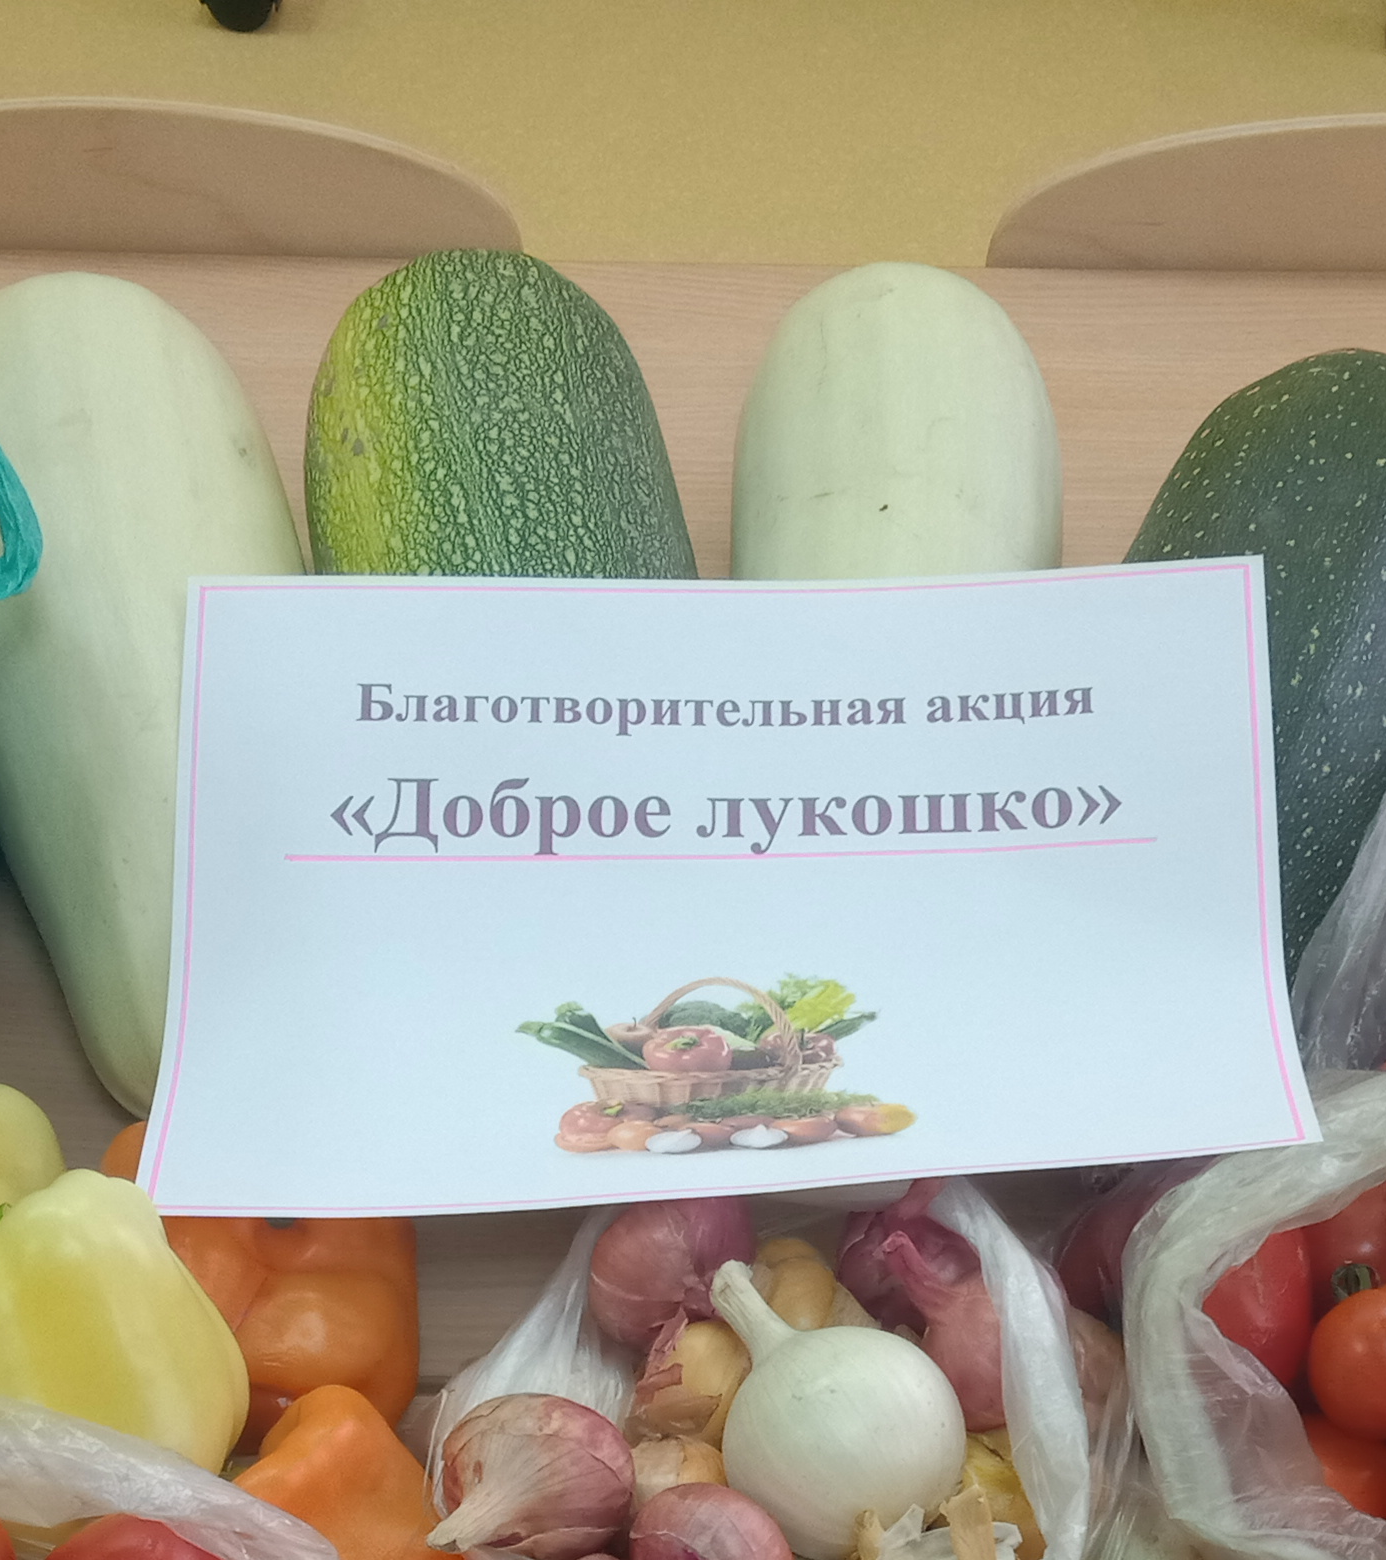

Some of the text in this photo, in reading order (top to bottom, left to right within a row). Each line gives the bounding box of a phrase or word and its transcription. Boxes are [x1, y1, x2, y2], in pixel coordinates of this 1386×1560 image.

[356, 683, 1094, 736] Благотворительная акция
[329, 777, 1123, 855] «Доброе лукошко»
